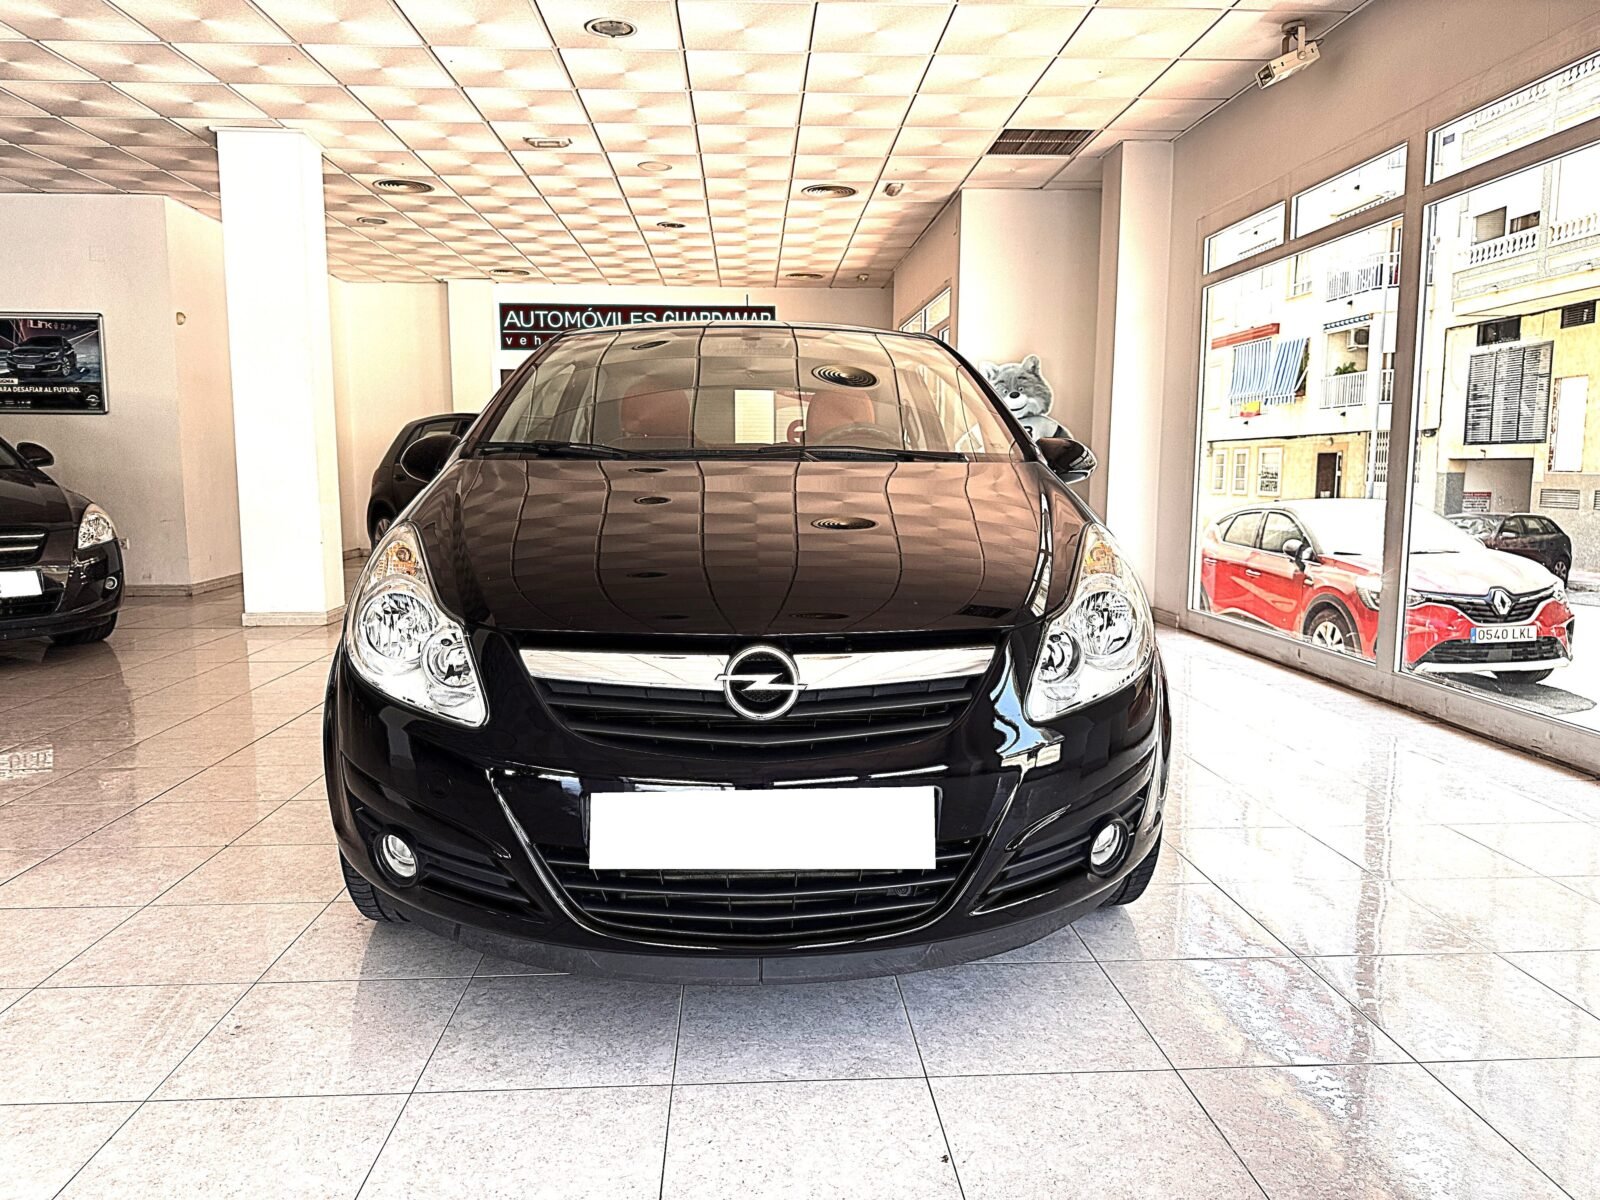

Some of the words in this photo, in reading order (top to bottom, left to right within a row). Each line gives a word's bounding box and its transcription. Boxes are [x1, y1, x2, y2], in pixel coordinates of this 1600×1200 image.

[503, 307, 656, 328] AUTOMÓVILES
[1477, 628, 1509, 640] 0540
[1512, 627, 1534, 640] LKL
